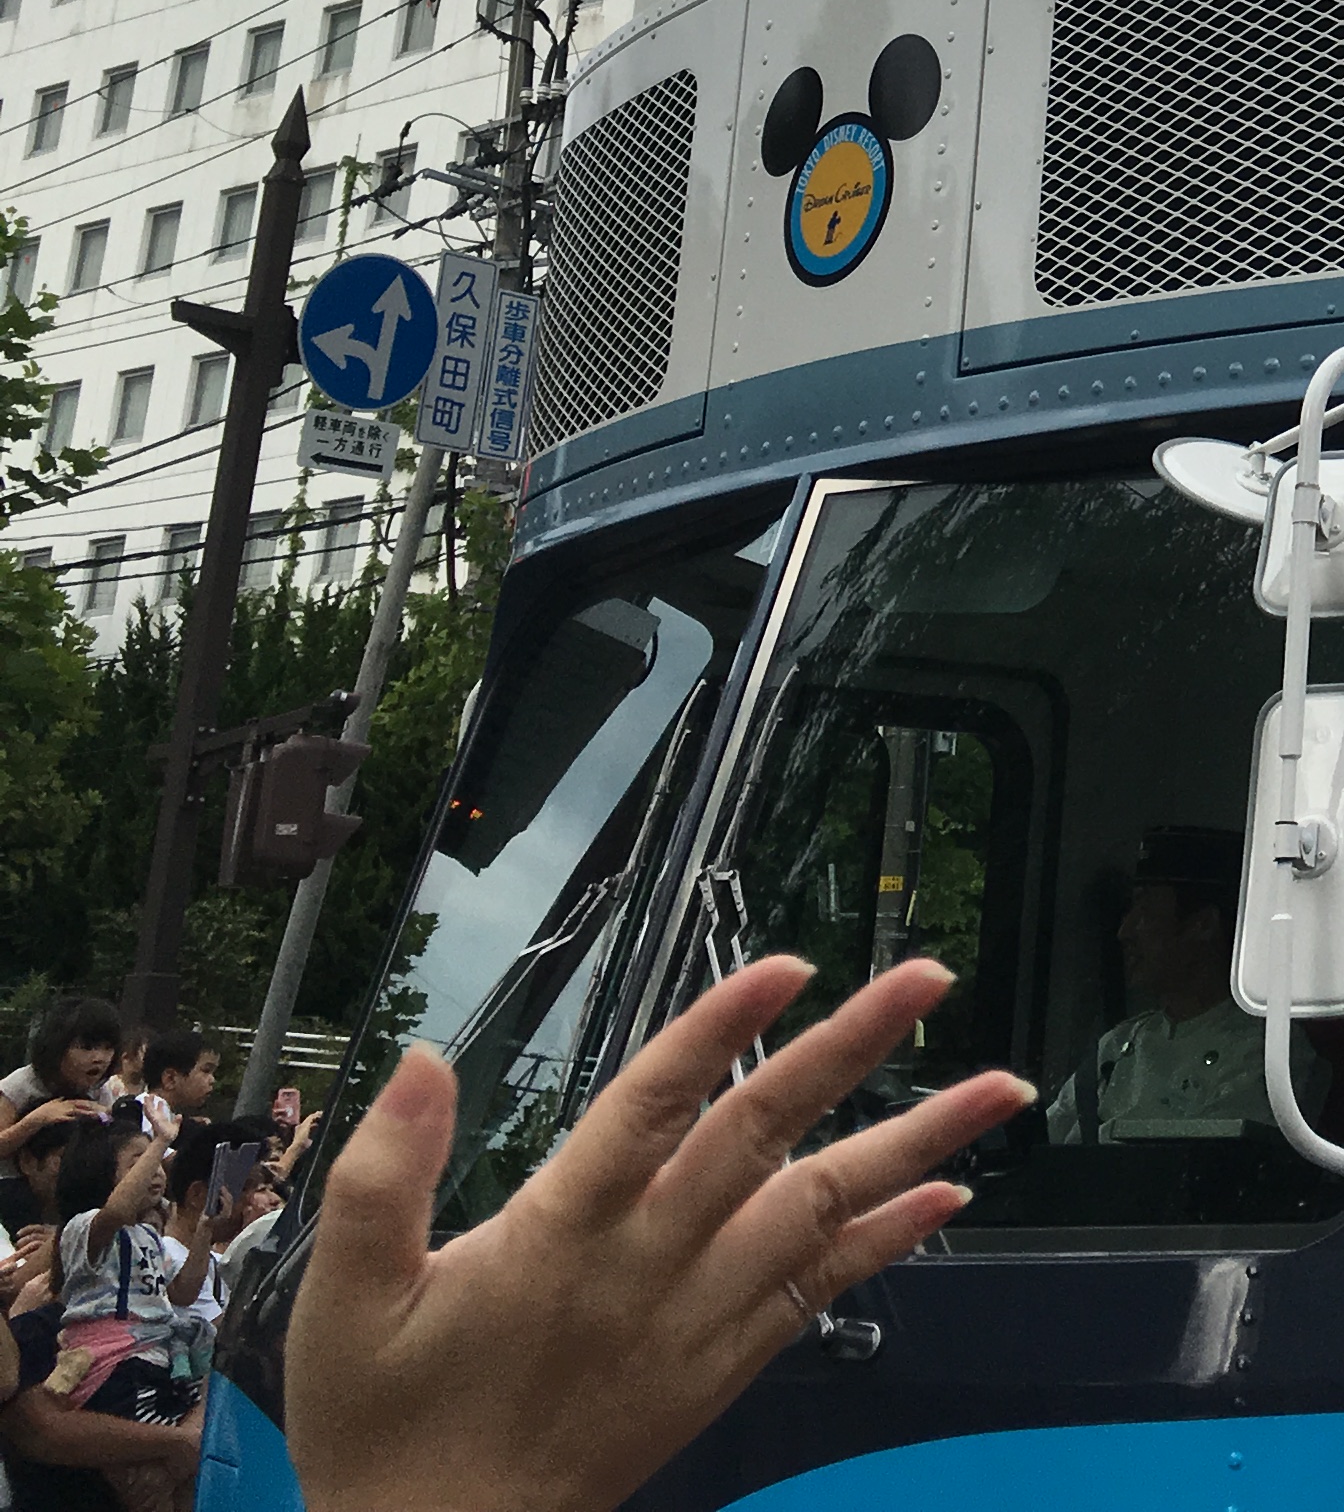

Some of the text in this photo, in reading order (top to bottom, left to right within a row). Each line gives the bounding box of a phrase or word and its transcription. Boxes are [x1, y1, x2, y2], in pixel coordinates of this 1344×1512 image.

[795, 124, 886, 193] TOKYO DISNEY RESORT
[431, 270, 482, 436] 久保田町
[488, 300, 531, 452] 歩車分離式信号
[313, 414, 390, 443] 軽車両を除く
[316, 437, 383, 459] 一方通行
